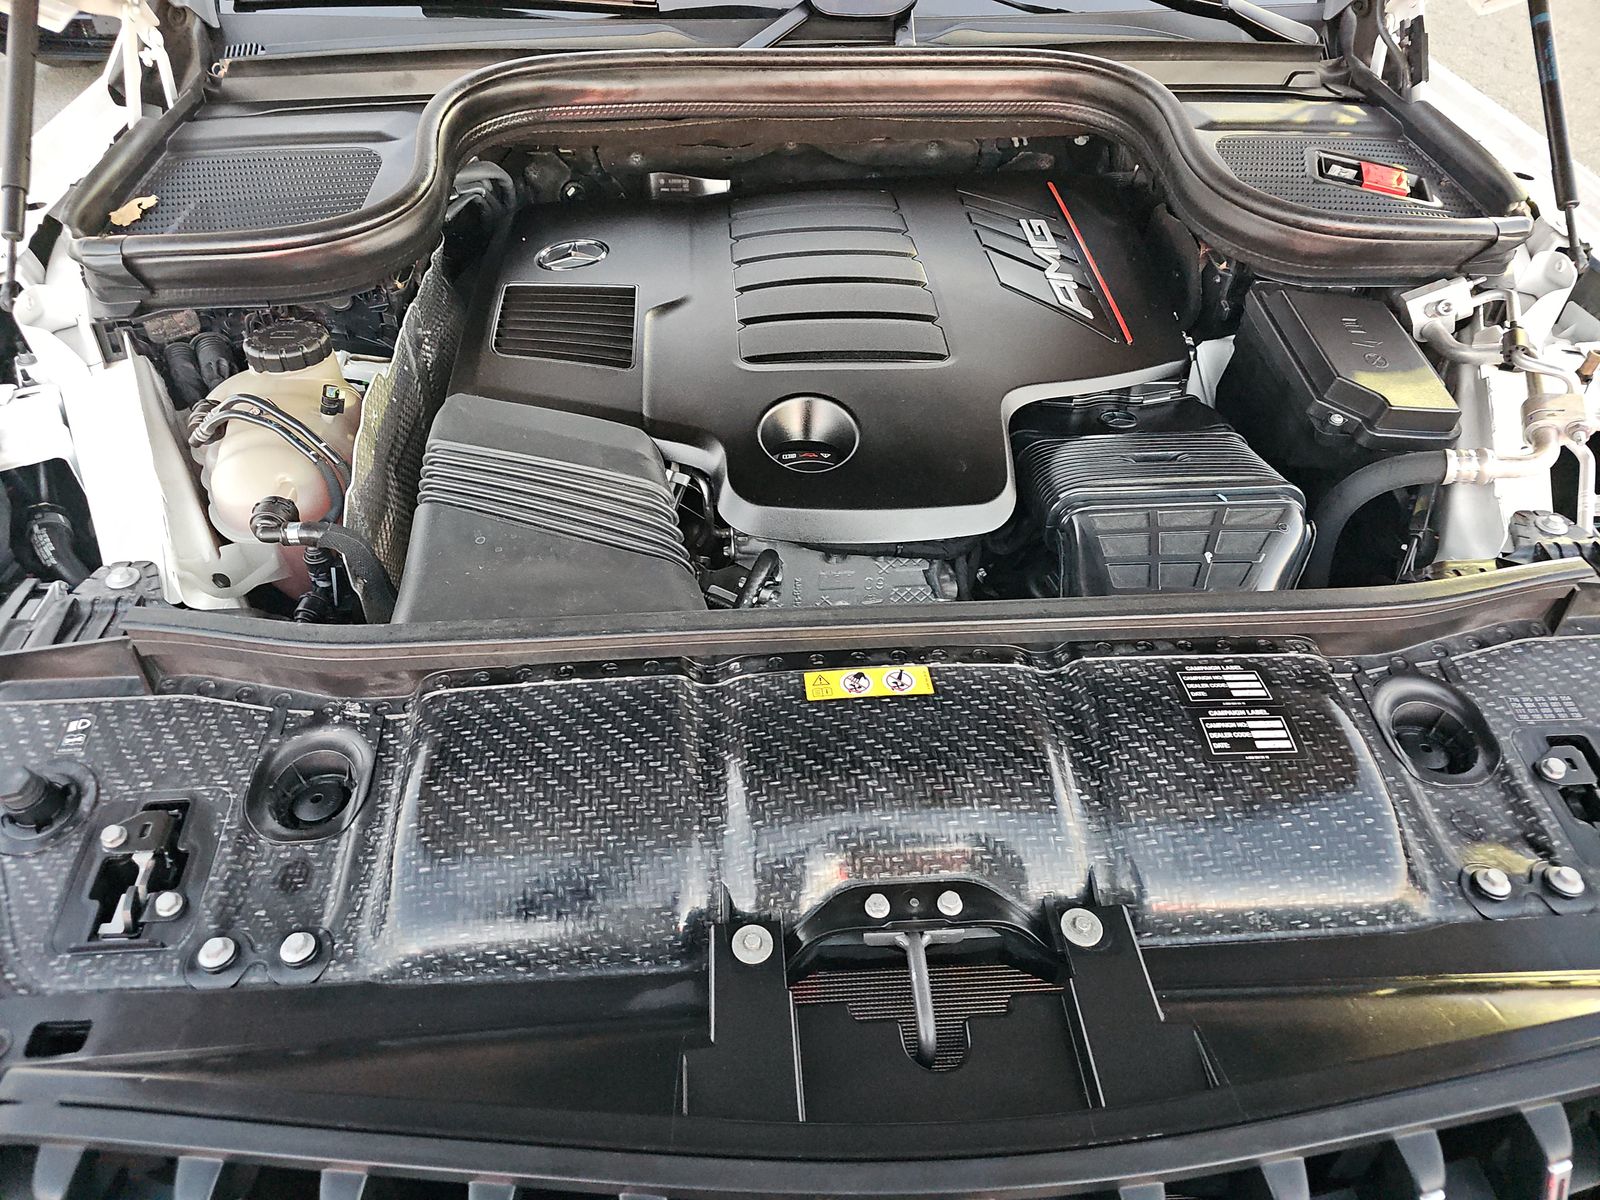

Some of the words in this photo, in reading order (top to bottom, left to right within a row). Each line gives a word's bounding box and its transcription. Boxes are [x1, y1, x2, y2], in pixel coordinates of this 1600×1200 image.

[1019, 218, 1094, 319] AMG
[1207, 709, 1246, 717] CAMPAIGN
[1246, 708, 1270, 716] LABEL
